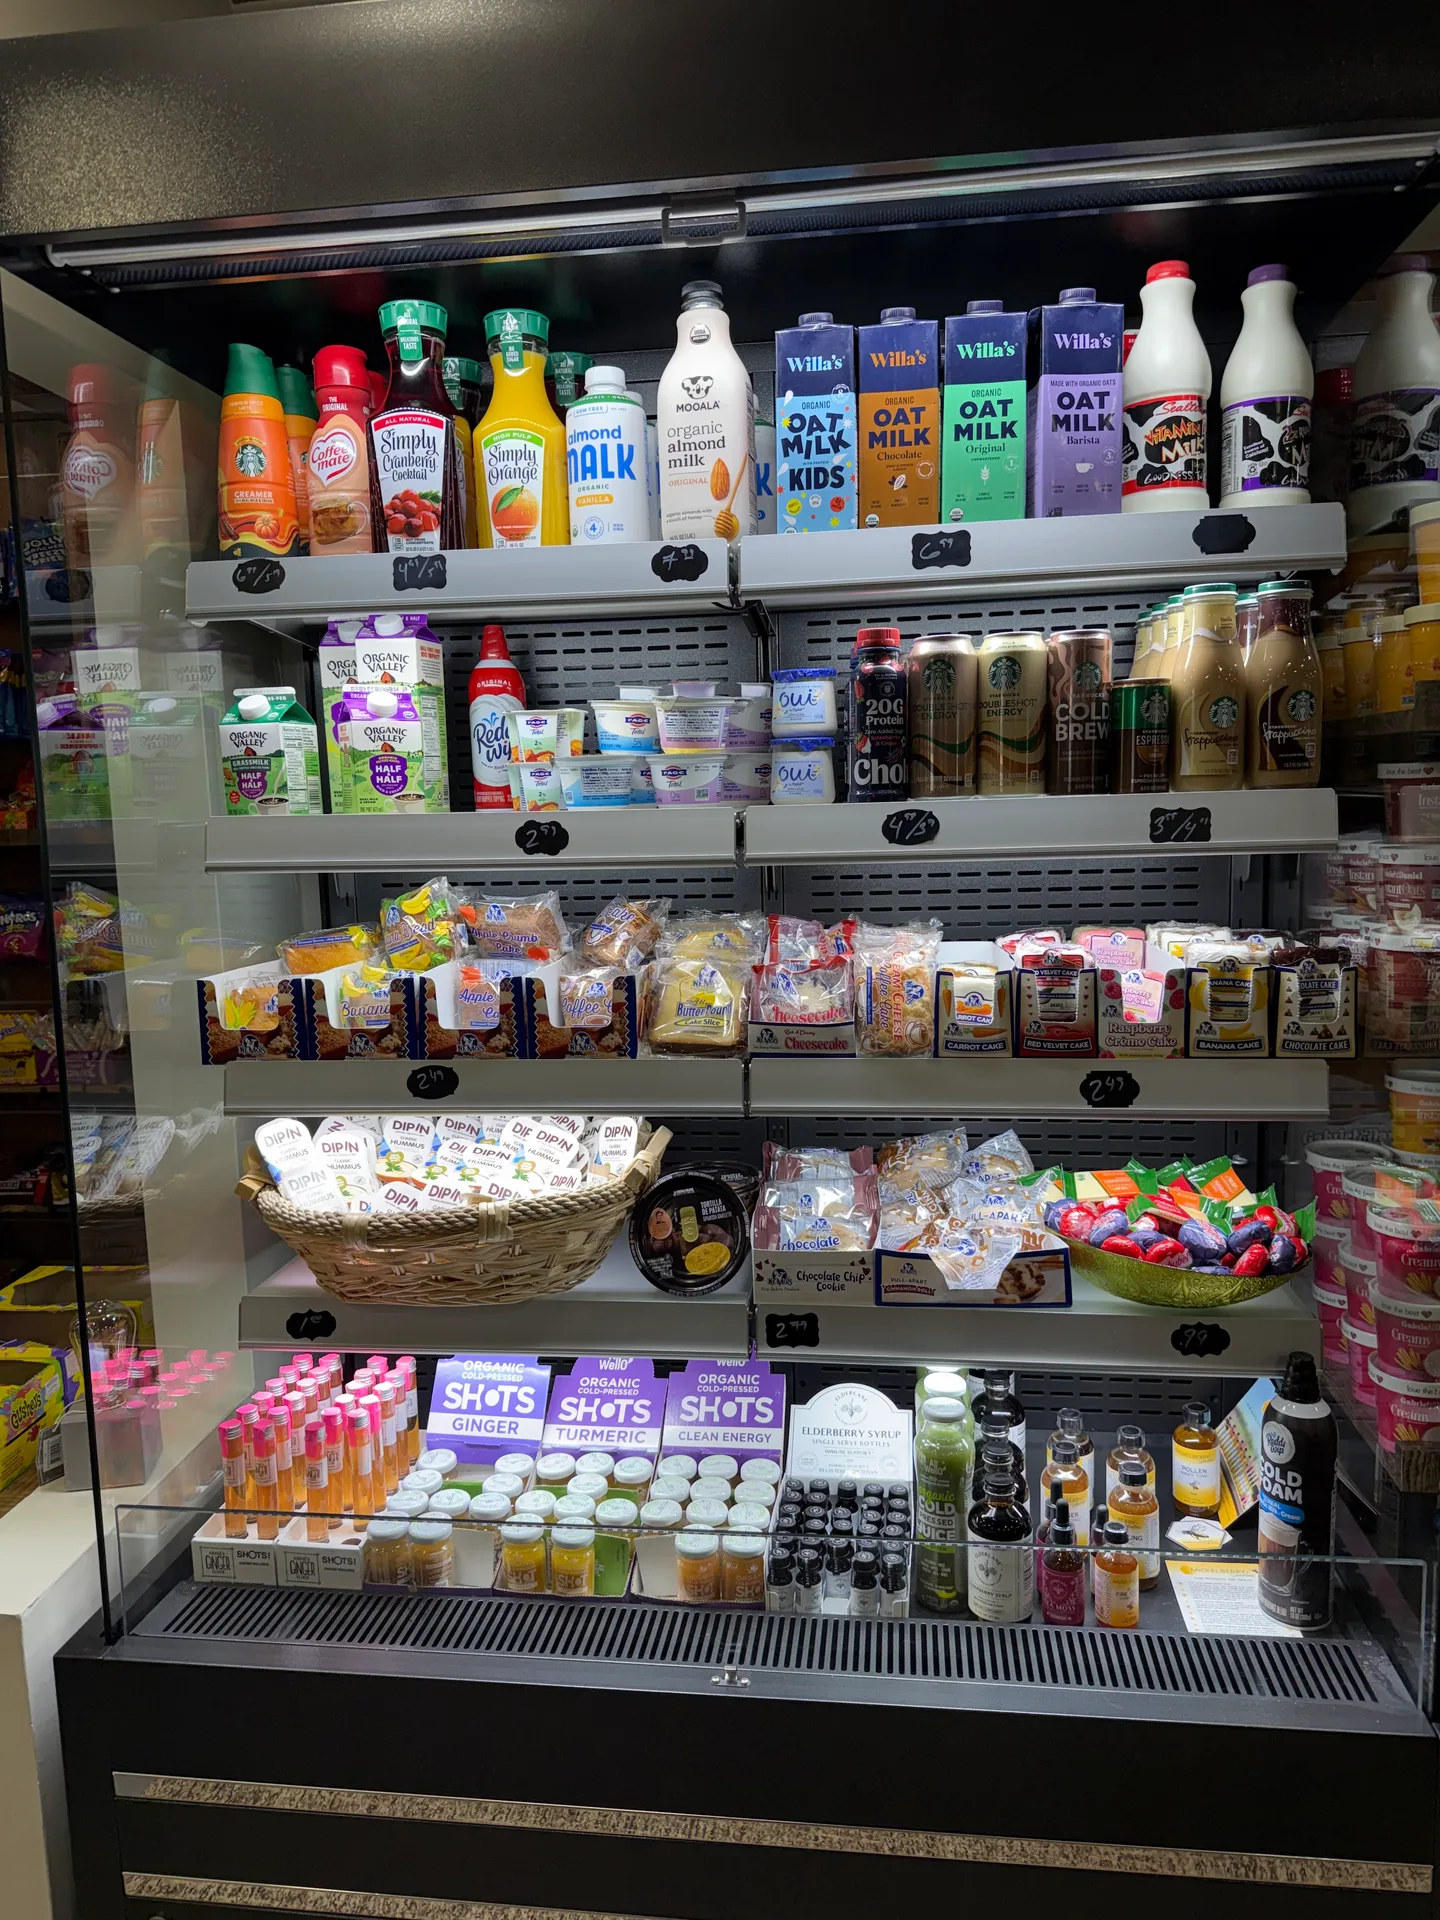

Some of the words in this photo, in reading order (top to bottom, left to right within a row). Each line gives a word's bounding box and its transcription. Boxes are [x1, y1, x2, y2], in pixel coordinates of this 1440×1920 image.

[1053, 332, 1112, 351] Willa's
[956, 341, 1015, 360] Willa's
[786, 354, 843, 373] Willa's
[870, 350, 927, 368] Willa's
[971, 388, 1002, 398] ORGANIC
[322, 403, 349, 412] ORIGINAL
[676, 402, 719, 413] MOOALA
[801, 400, 831, 410] ORGANIC
[885, 396, 915, 406] ORGANIC
[1056, 391, 1111, 411] OAT
[959, 398, 1013, 420] OAT
[873, 406, 926, 428] OAT
[1051, 413, 1115, 432] MILK
[667, 421, 723, 439] organic
[787, 411, 844, 437] OAT
[492, 434, 511, 442] HIGH
[513, 432, 532, 440] PULP
[568, 426, 622, 444] almond
[954, 420, 1018, 442] MILK
[381, 429, 437, 455] Simply
[868, 427, 931, 449] MILK
[1066, 435, 1100, 445] Barista
[667, 437, 726, 454] almond
[781, 429, 852, 461] MILK
[965, 443, 1006, 457] Original
[311, 445, 348, 464] Coffee
[488, 447, 536, 469] Simply
[877, 450, 922, 462] Chocolate
[317, 454, 350, 471] mate
[382, 451, 438, 474] Cranberry
[668, 454, 706, 470] milk
[392, 468, 428, 482] Cocktail
[488, 464, 538, 485] Orange
[789, 466, 845, 492] KIDS
[577, 484, 610, 493] ORGANIC
[668, 477, 709, 488] ORIGINAL
[577, 496, 610, 506] VANILLA
[22, 535, 66, 552] JOLLY
[362, 652, 410, 666] ORGANIC
[367, 662, 406, 674] VALLEY
[477, 679, 512, 688] ORIGINAL
[979, 699, 1037, 710] DOUBLESHOT
[986, 708, 1023, 718] ENERGY
[1055, 701, 1110, 722] COLD
[865, 715, 904, 726] Protein
[230, 731, 268, 742] ORGANIC
[364, 726, 407, 737] ORGANIC
[1055, 721, 1110, 742] BREW
[1262, 722, 1316, 744] frappuccino
[233, 739, 265, 749] VALLEY
[369, 734, 403, 744] VALLEY
[1184, 728, 1239, 749] frappuccino
[232, 758, 270, 767] GRASSMILK
[375, 765, 402, 773] HALF
[241, 772, 262, 780] HALF
[376, 775, 403, 784] HALF
[242, 781, 263, 789] HALF
[458, 988, 493, 1004] Apple
[677, 1002, 704, 1017] Butter
[704, 1002, 732, 1016] Pound
[1108, 1023, 1171, 1036] Raspberry
[785, 1037, 848, 1051] Cheesecake
[947, 1042, 980, 1051] CARROT
[981, 1042, 1005, 1051] CAKE
[1042, 1041, 1068, 1049] VELVET
[1069, 1041, 1089, 1049] CAKE
[1105, 1036, 1146, 1047] Crème
[1148, 1036, 1178, 1047] Cake
[1200, 1041, 1235, 1050] BANANA
[1237, 1041, 1260, 1049] CAKE
[1284, 1040, 1328, 1051] CHOCOLATE
[1329, 1040, 1349, 1049] CAKE
[390, 1139, 425, 1151] HUMMUS
[700, 1198, 722, 1209] TORTILLA
[709, 1205, 727, 1214] PATATA
[796, 1271, 841, 1282] Chocolate
[843, 1270, 866, 1284] Chip
[890, 1277, 928, 1285] PULL-APART
[816, 1281, 846, 1291] Cookie
[462, 1360, 525, 1374] ORGANIC
[461, 1371, 524, 1382] COLD-PRESSED
[579, 1376, 640, 1389] ORGANIC
[698, 1374, 760, 1387] ORGANIC
[577, 1386, 639, 1396] COLD-PRESSED
[697, 1384, 760, 1394] COLD-PRESSED
[442, 1381, 536, 1414] SHOTS
[11, 1394, 43, 1430] Gushers
[558, 1397, 652, 1425] SHOTS
[680, 1395, 775, 1424] SHOTS
[452, 1416, 520, 1435] GINGER
[555, 1427, 647, 1444] TURMERIC
[678, 1431, 721, 1443] CLEAN
[723, 1431, 772, 1444] ENERGY
[801, 1426, 865, 1438] ELDERBERRY
[868, 1429, 901, 1439] SYRUP
[811, 1438, 836, 1446] SINGLE
[836, 1439, 858, 1447] SERVE
[859, 1440, 891, 1448] BOTTLES
[1181, 1465, 1208, 1474] POLLEN
[236, 1550, 271, 1560] SHOTS!
[321, 1555, 357, 1566] SHOTS!
[205, 1554, 231, 1571] GINGER
[289, 1560, 316, 1577] GINGER
[1056, 1604, 1077, 1613] MOSS
